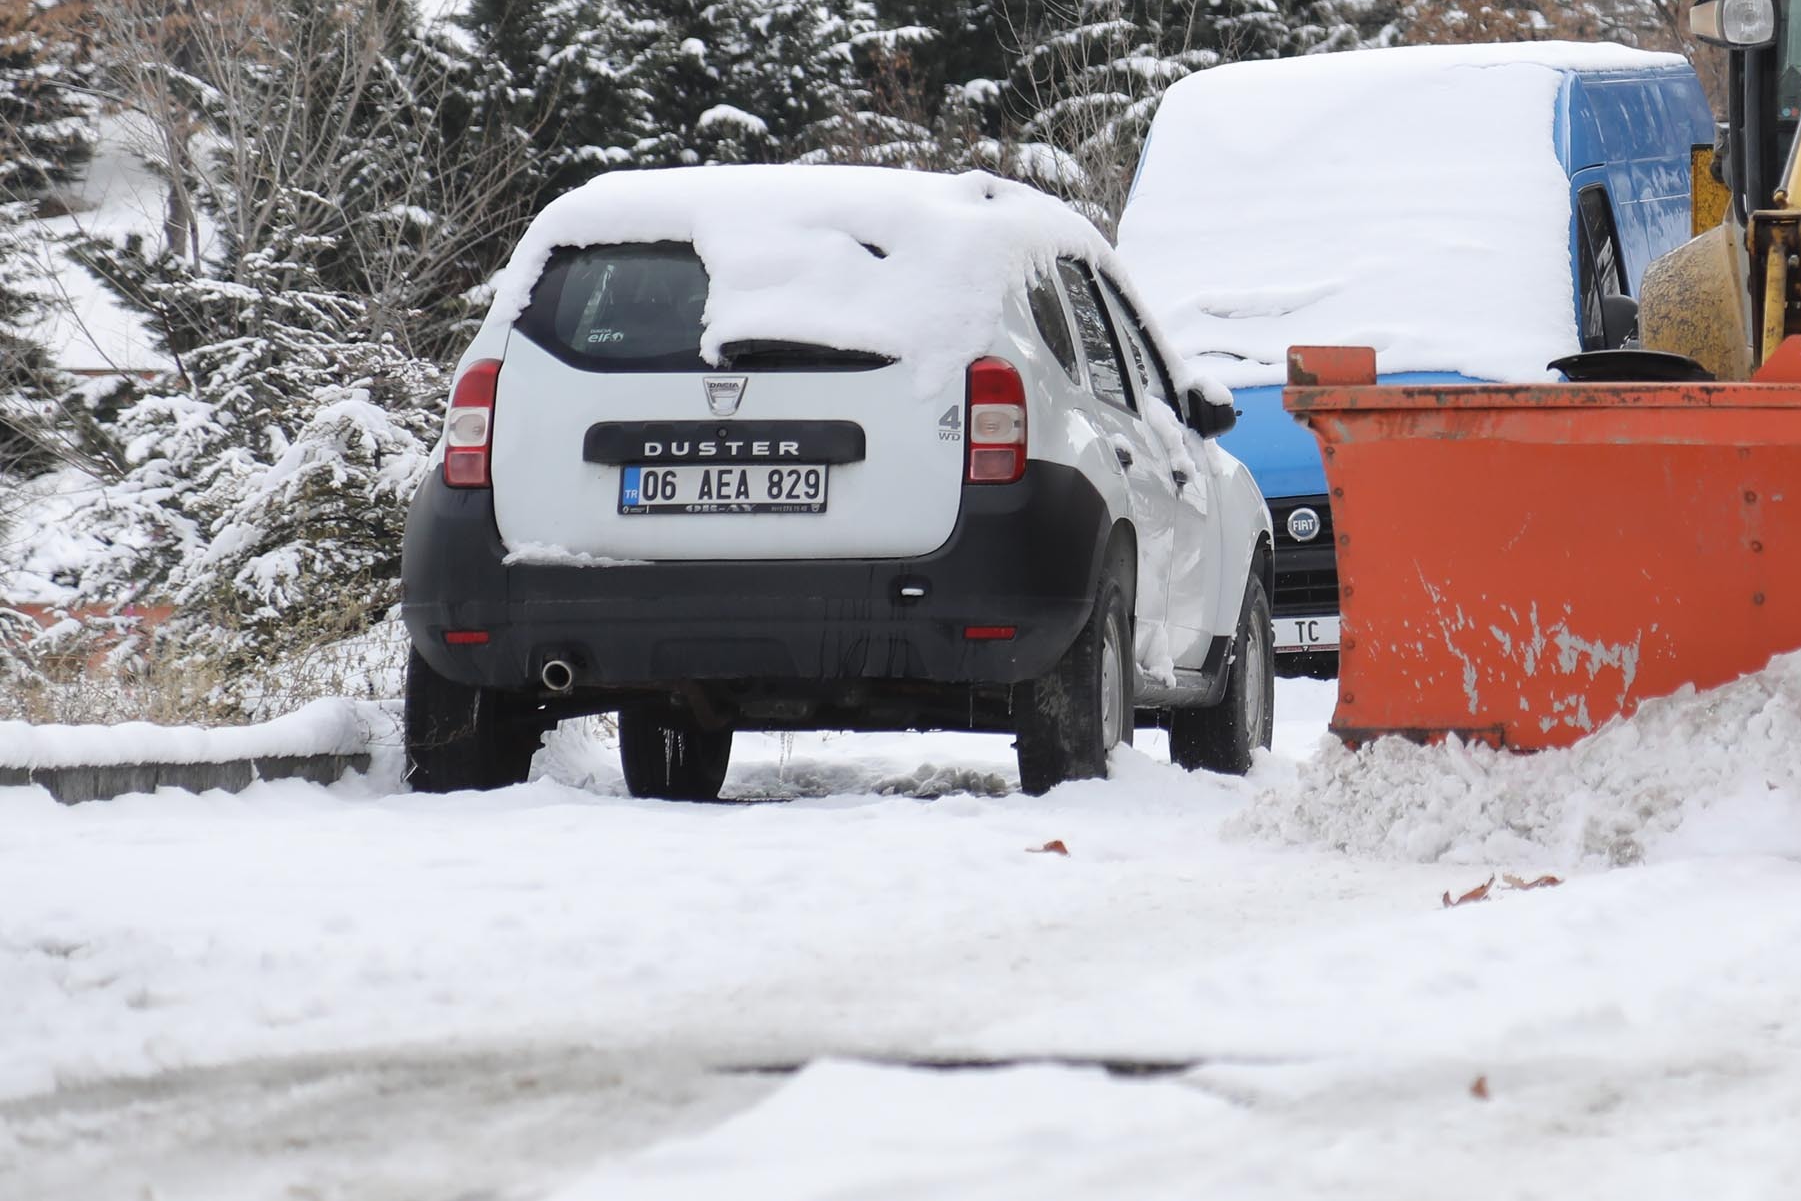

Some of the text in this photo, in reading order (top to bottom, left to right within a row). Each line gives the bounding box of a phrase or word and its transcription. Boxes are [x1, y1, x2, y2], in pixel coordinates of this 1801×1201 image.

[587, 333, 611, 343] elf
[938, 405, 961, 430] 4
[938, 432, 960, 441] WD
[644, 441, 799, 456] DUSTER
[625, 469, 820, 501] TR 06 AEA 829
[1292, 519, 1315, 531] FIAT
[1295, 620, 1319, 643] TC
